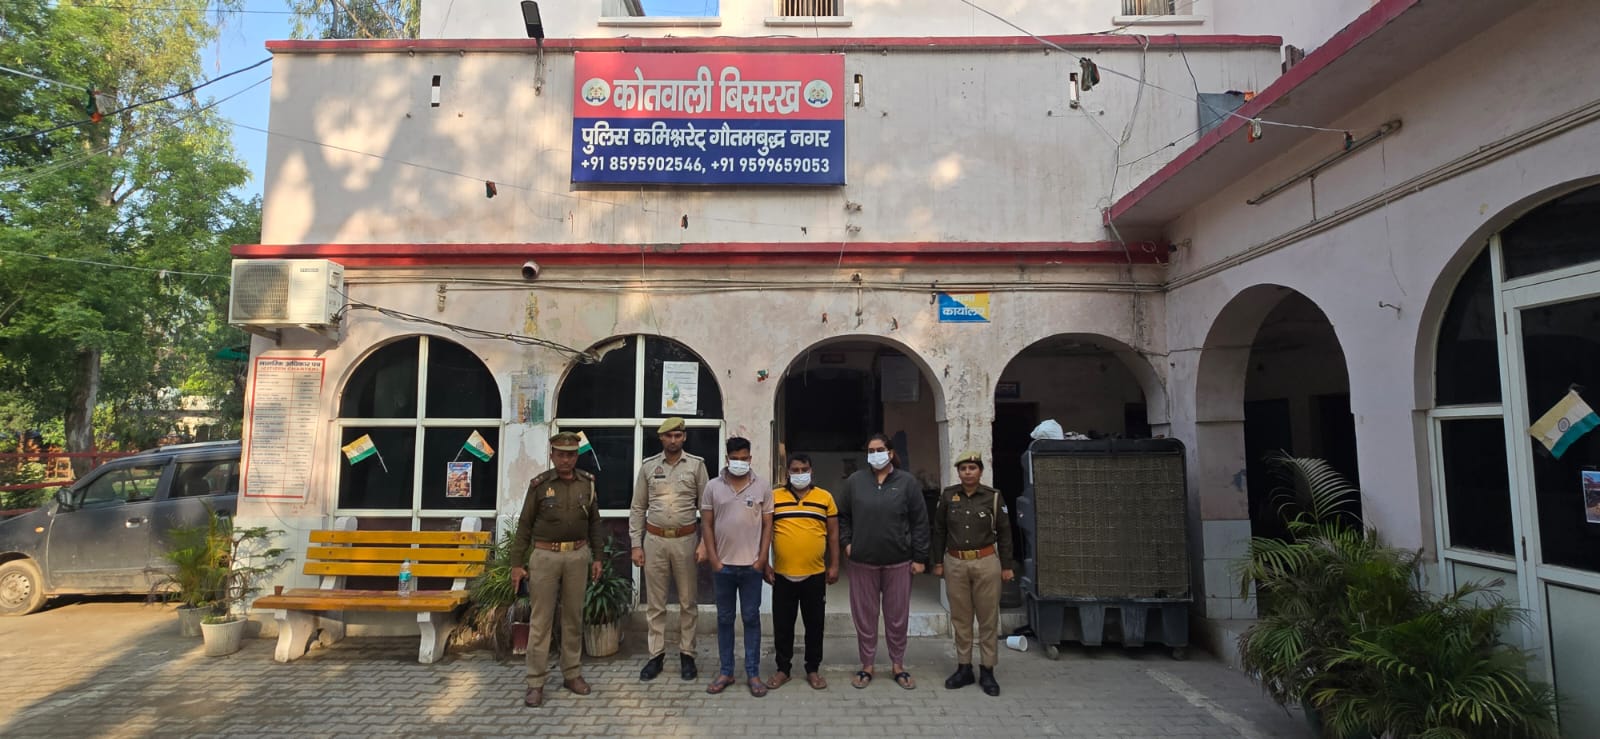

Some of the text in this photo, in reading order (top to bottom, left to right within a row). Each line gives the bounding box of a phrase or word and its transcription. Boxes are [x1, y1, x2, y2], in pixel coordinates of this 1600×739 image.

[613, 66, 802, 114] कोतवाली बिसरख
[582, 121, 630, 154] पुलिस
[709, 121, 787, 156] गौतमबुद्ध
[790, 129, 831, 147] नगर
[581, 157, 830, 174] +91 8595902546, +91 9599659053
